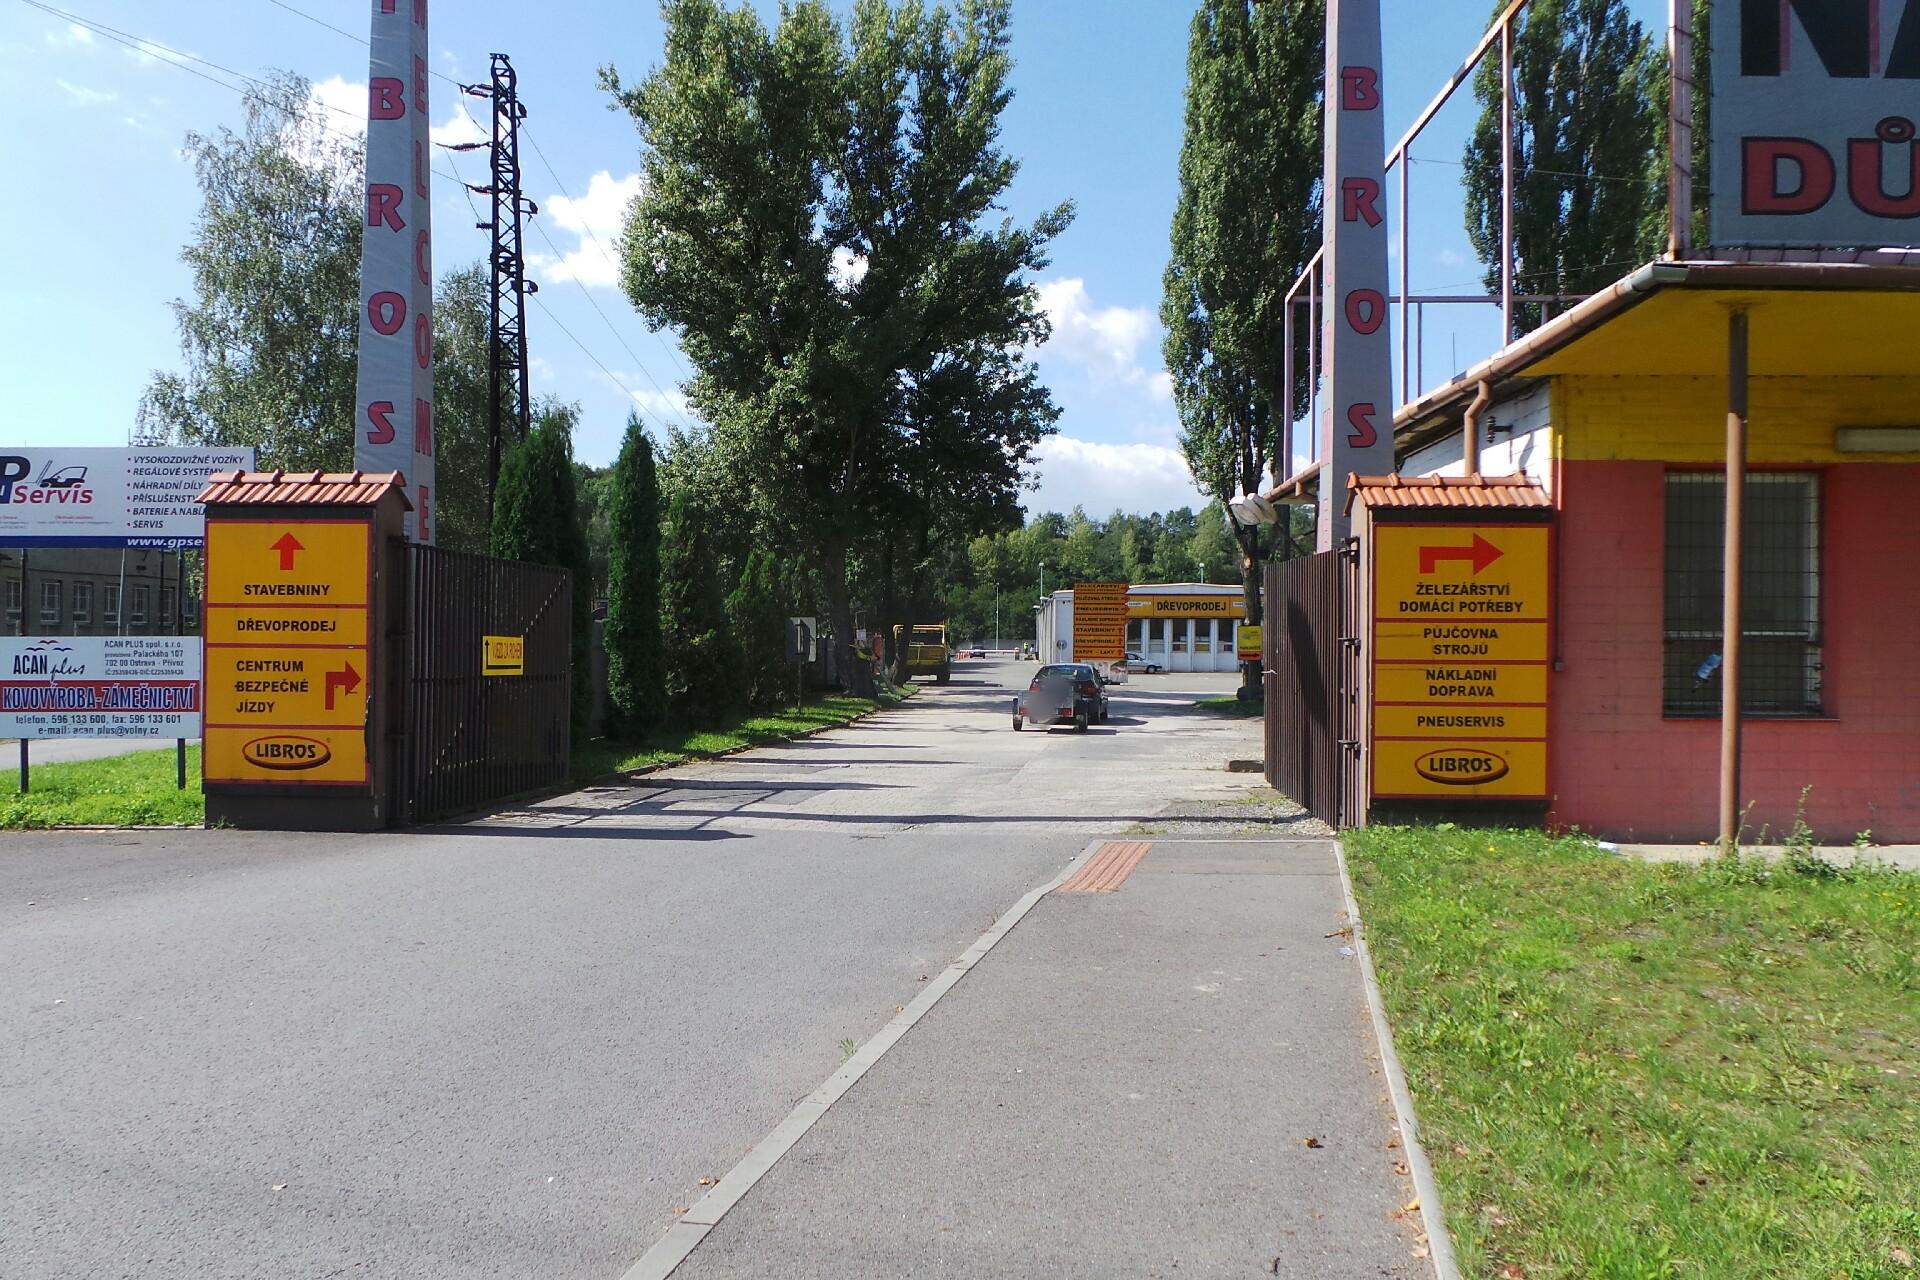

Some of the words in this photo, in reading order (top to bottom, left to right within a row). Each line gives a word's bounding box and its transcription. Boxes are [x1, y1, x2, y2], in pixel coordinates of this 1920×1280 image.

[1341, 66, 1385, 448] BROS
[134, 455, 210, 464] VYSOKOZDVIŽNÉ
[212, 455, 244, 464] VOZÍKY
[133, 467, 181, 476] REGÁLOVÉ
[132, 480, 182, 489] NÁHRADNÍ
[184, 480, 203, 489] DÍLY
[13, 484, 93, 503] Servis
[133, 507, 169, 515] BATERIE
[133, 520, 164, 528] SERVIS
[127, 538, 204, 548] www.gpse
[243, 584, 330, 596] STAVEBNINY
[1416, 581, 1510, 596] ŽELEZÁŘSTVÍ
[1157, 600, 1226, 611] DŘEVOPRODEJ
[1399, 598, 1454, 612] DOMÁCÍ
[1459, 598, 1523, 612] POTŘEBY
[237, 618, 336, 632] DŘEVOPRODEJ
[1423, 624, 1498, 639] PŮJČOVNA
[1433, 641, 1488, 655] STROJŮ
[13, 654, 47, 675] ACAN
[50, 656, 85, 682] plus
[236, 660, 304, 672] CENTRUM
[1426, 667, 1496, 681] NÁKLADNÍ
[236, 678, 309, 692] BEZPEČNÉ
[1429, 685, 1494, 697] DOPRAVA
[236, 699, 275, 713] JÍZDY
[51, 714, 68, 724] 596
[70, 714, 87, 724] 133
[129, 714, 145, 724] 596
[147, 714, 163, 724] 133
[165, 714, 181, 724] 601
[1417, 716, 1505, 727] PNEUSERVIS
[256, 743, 316, 759] LIBROS
[1429, 757, 1493, 773] LIBROS
